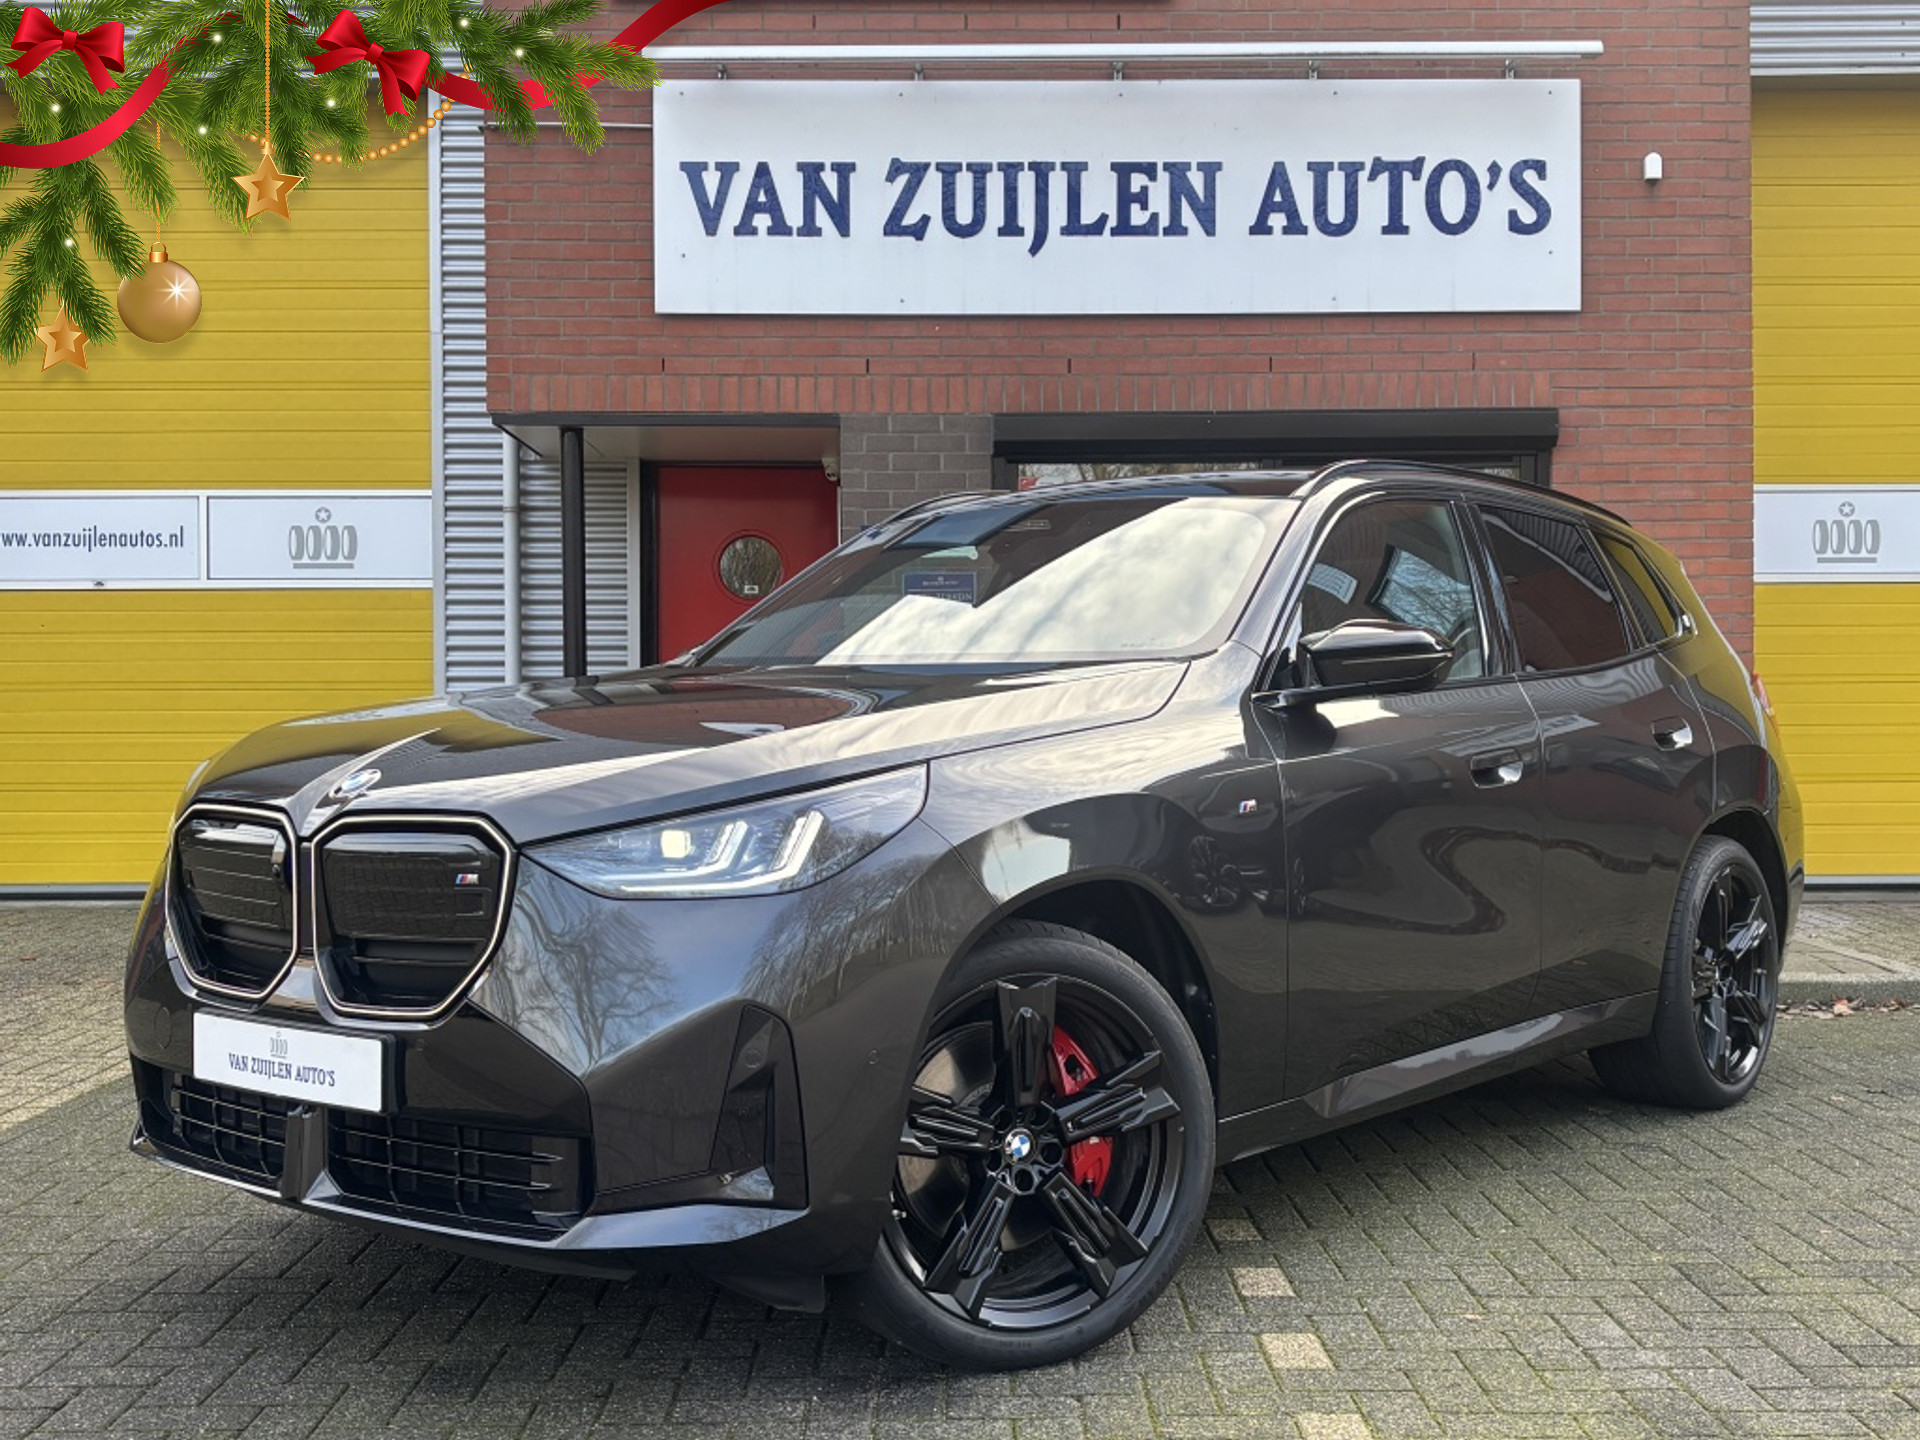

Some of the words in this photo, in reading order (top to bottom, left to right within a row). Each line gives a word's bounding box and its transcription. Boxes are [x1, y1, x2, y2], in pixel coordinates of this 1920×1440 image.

[679, 161, 857, 238] VAN
[882, 157, 1223, 258] ZUIJLEN
[1248, 156, 1552, 238] AUTO'S
[0, 525, 184, 553] ww.vanzuijlenautos.nl
[228, 1052, 249, 1072] VAN
[251, 1056, 292, 1080] ZUIJLEN
[294, 1065, 336, 1087] AUTO'S
